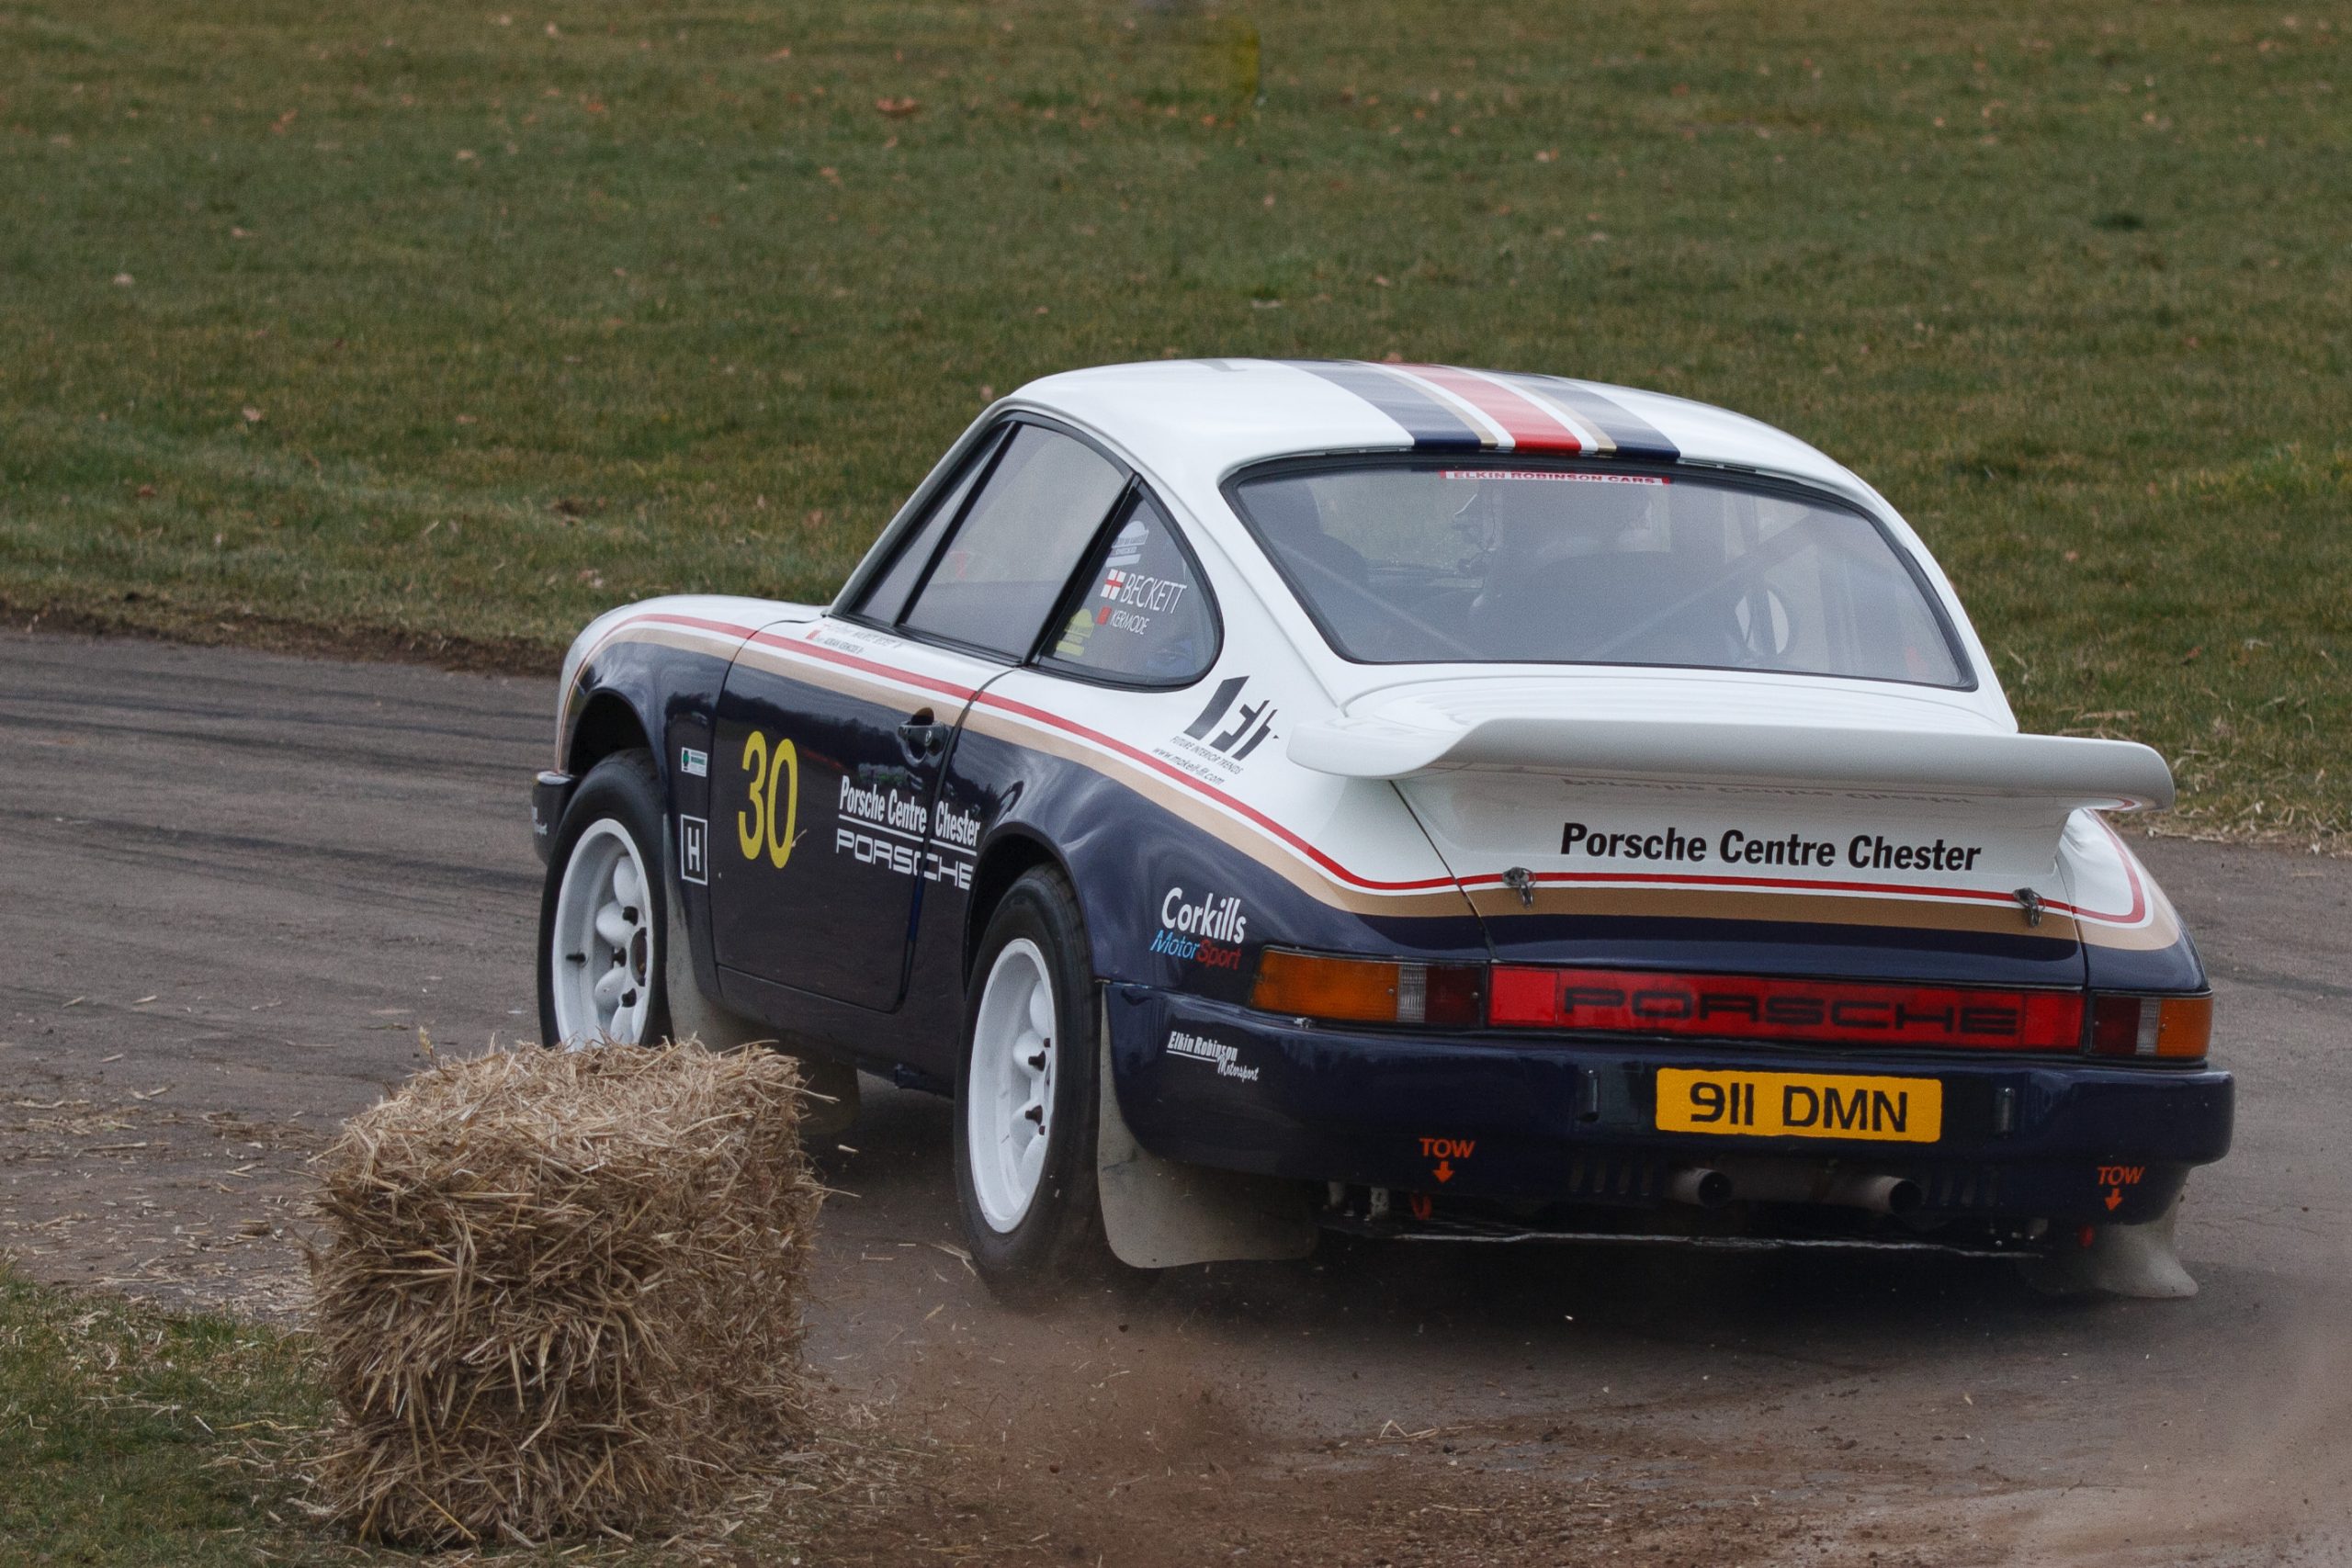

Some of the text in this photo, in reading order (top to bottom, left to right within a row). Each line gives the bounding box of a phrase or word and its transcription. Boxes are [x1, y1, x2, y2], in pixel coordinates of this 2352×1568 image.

[1453, 470, 1656, 485] ELKIN ROBINSON CARS
[1120, 573, 1187, 615] BECKETT
[1110, 609, 1150, 636] KERMODE
[738, 730, 798, 869] 30
[839, 774, 981, 848] Porsche Centre Chester
[687, 826, 700, 873] H
[836, 828, 974, 891] PORSCHE
[1560, 822, 1983, 872] Porsche Centre Chester
[1161, 886, 1247, 944] Corkills
[1563, 986, 2018, 1037] PORSCHE
[1167, 1031, 1238, 1062] Elkin Robinson
[1216, 1055, 1260, 1082] Motorsport
[1690, 1081, 1908, 1133] 911 DMN
[1419, 1138, 1476, 1158] TOW
[2097, 1166, 2145, 1186] TOW
